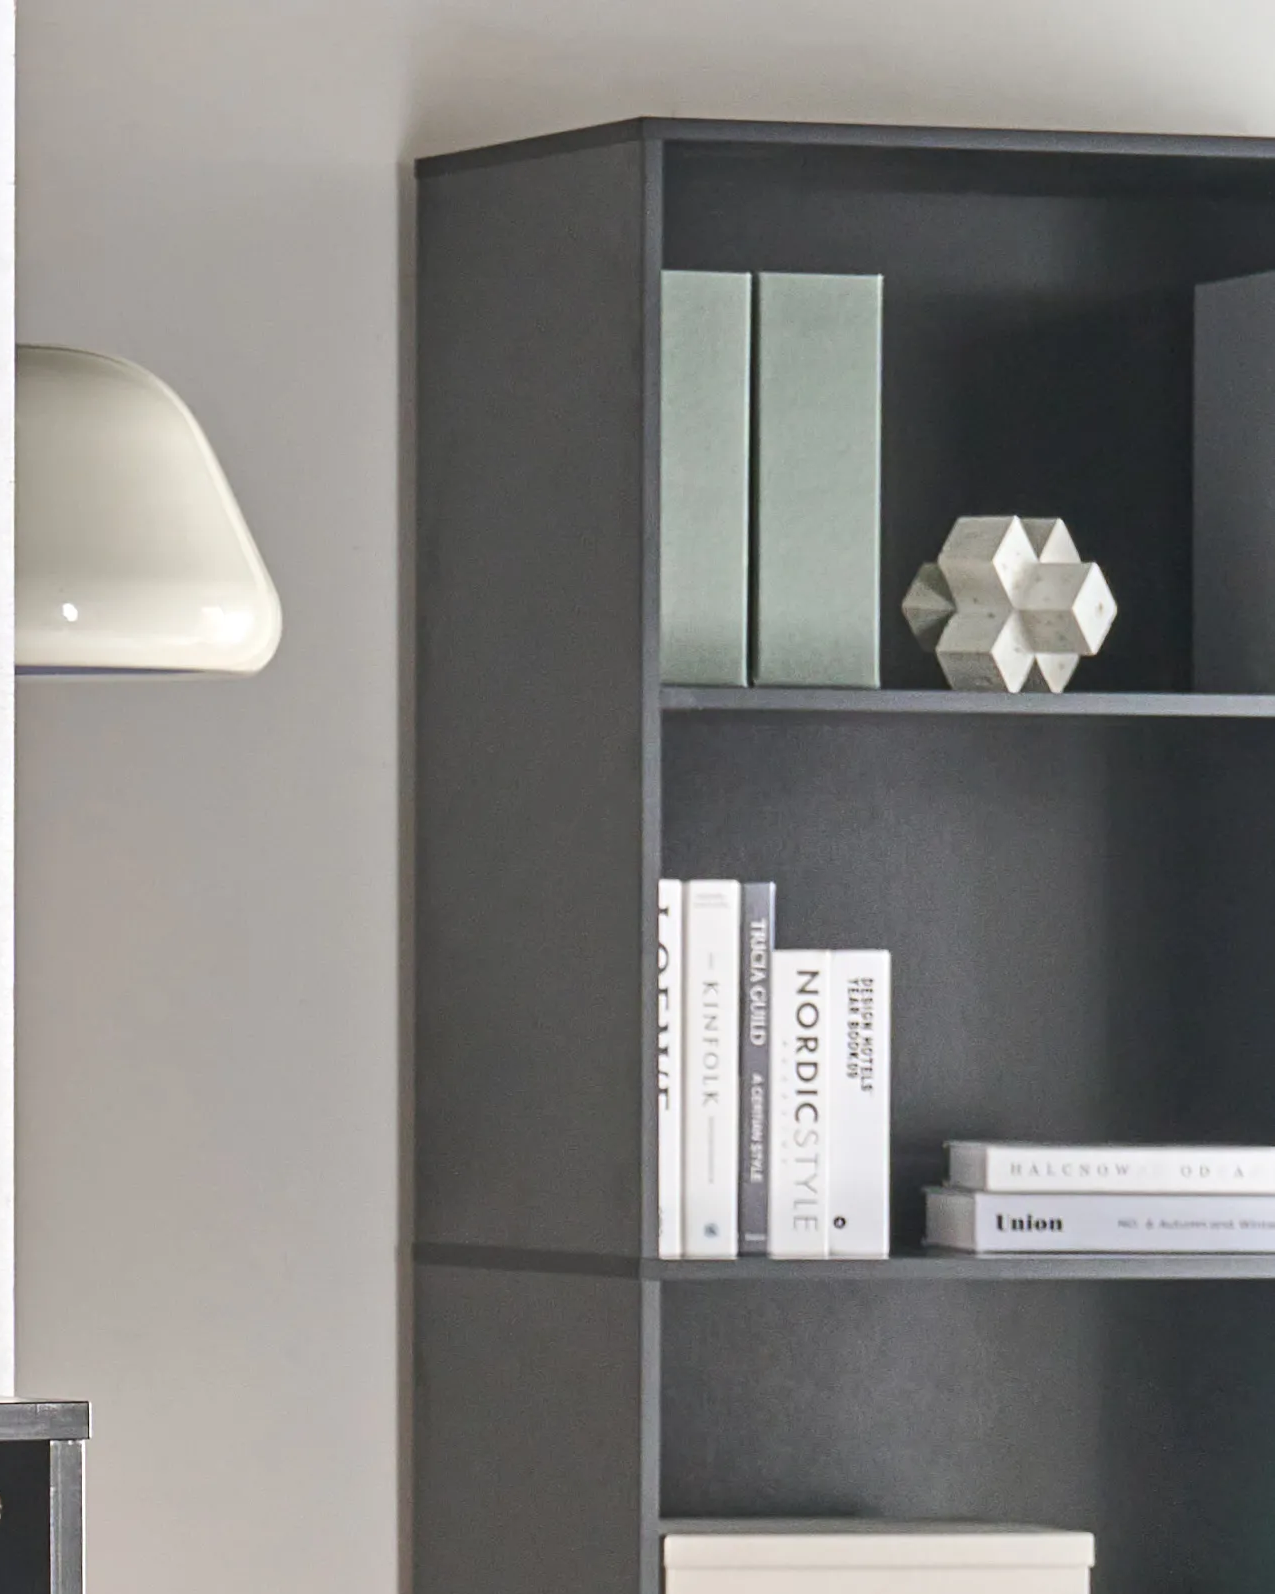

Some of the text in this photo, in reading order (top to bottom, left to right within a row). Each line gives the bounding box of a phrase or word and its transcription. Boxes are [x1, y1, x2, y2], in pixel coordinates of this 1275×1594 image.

[750, 918, 766, 982] TRICIA
[750, 984, 766, 1046] GUILD
[847, 977, 860, 1015] YEAR
[702, 981, 720, 1107] KINFOLK
[847, 1021, 860, 1059] BOOK
[860, 977, 874, 1092] DESIGN HOTELS
[996, 1214, 1063, 1232] Union
